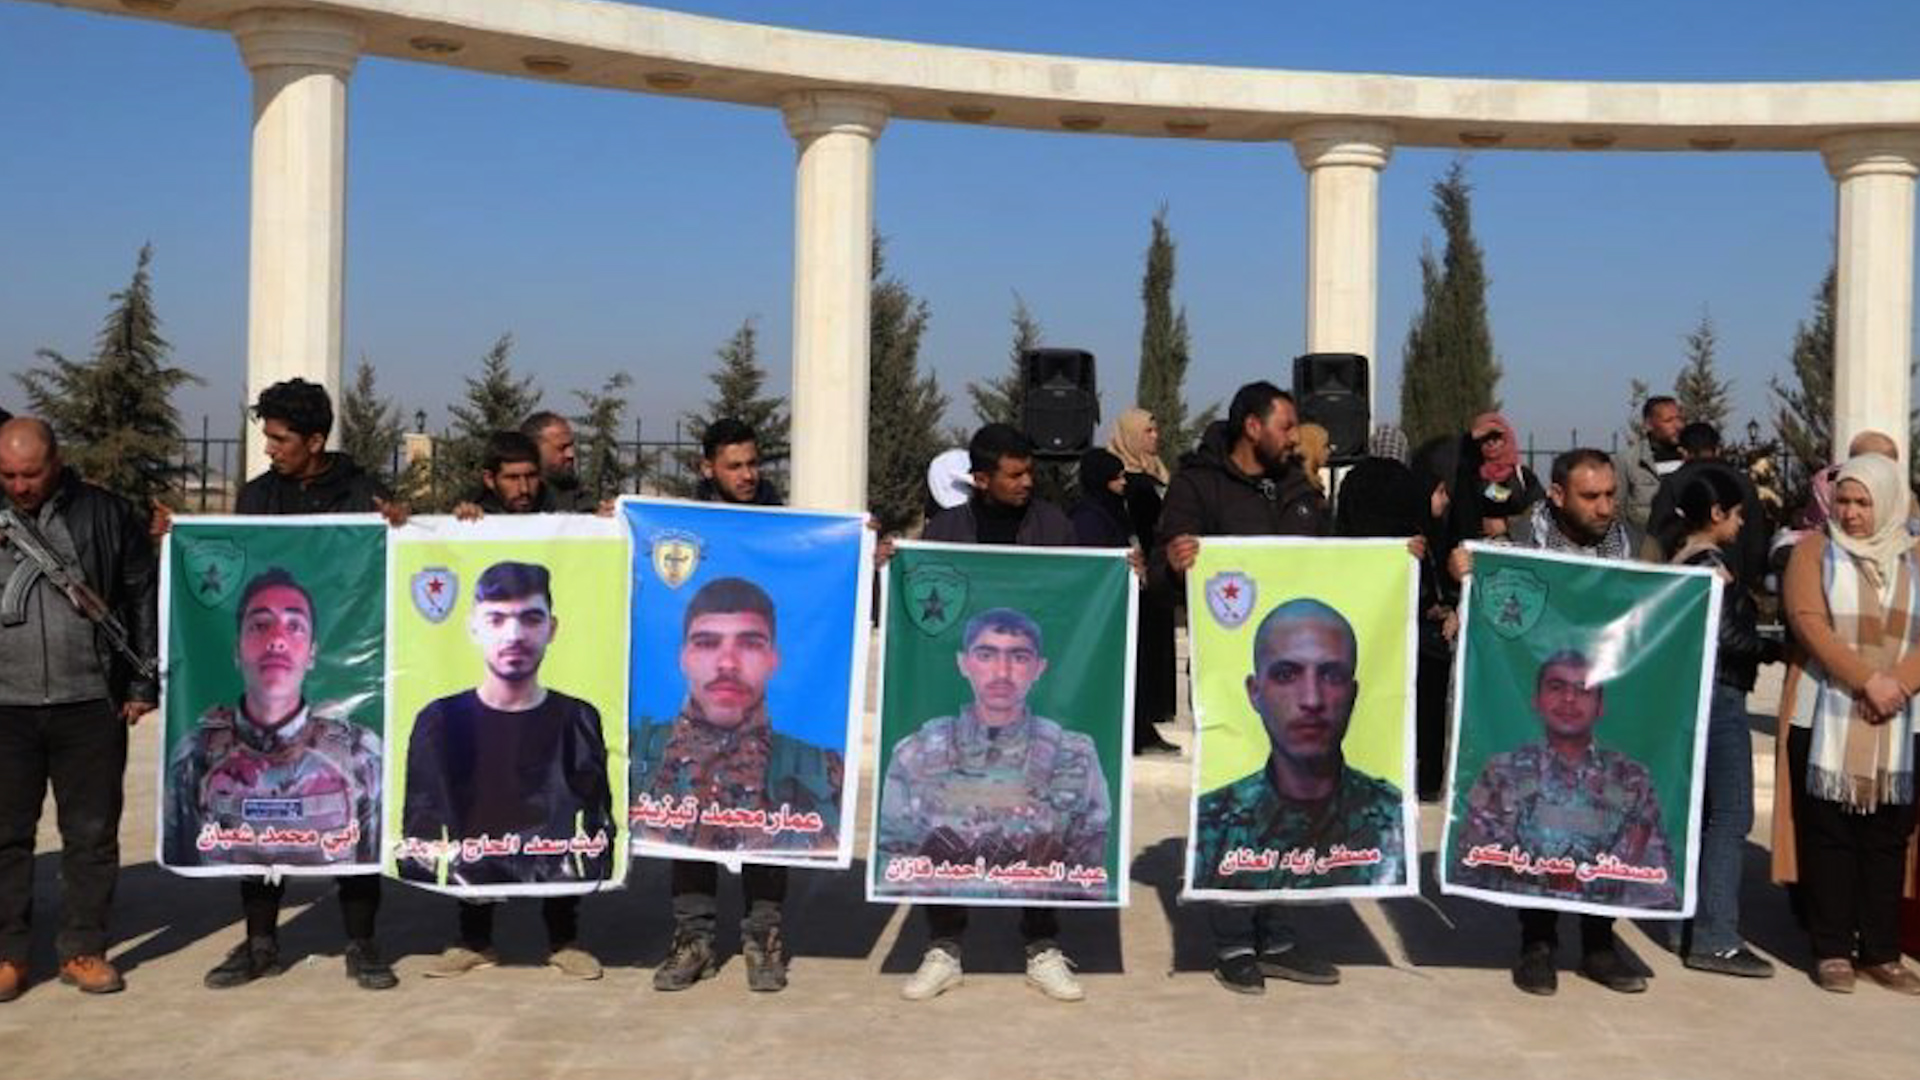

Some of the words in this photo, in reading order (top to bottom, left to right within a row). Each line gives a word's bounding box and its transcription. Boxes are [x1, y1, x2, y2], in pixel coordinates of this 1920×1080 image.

[629, 792, 699, 829] تيزين
[701, 803, 765, 826] محمد
[764, 802, 822, 834] عمار
[197, 821, 255, 850] شعبان
[258, 826, 318, 846] محمد
[524, 834, 568, 854] سعد
[935, 856, 986, 880] أحمد
[1280, 848, 1315, 874] زياد
[1314, 844, 1381, 874] مصطفى
[1527, 857, 1576, 874] عمر
[1576, 853, 1667, 884] مصطفى
[1068, 864, 1107, 887] عبد
